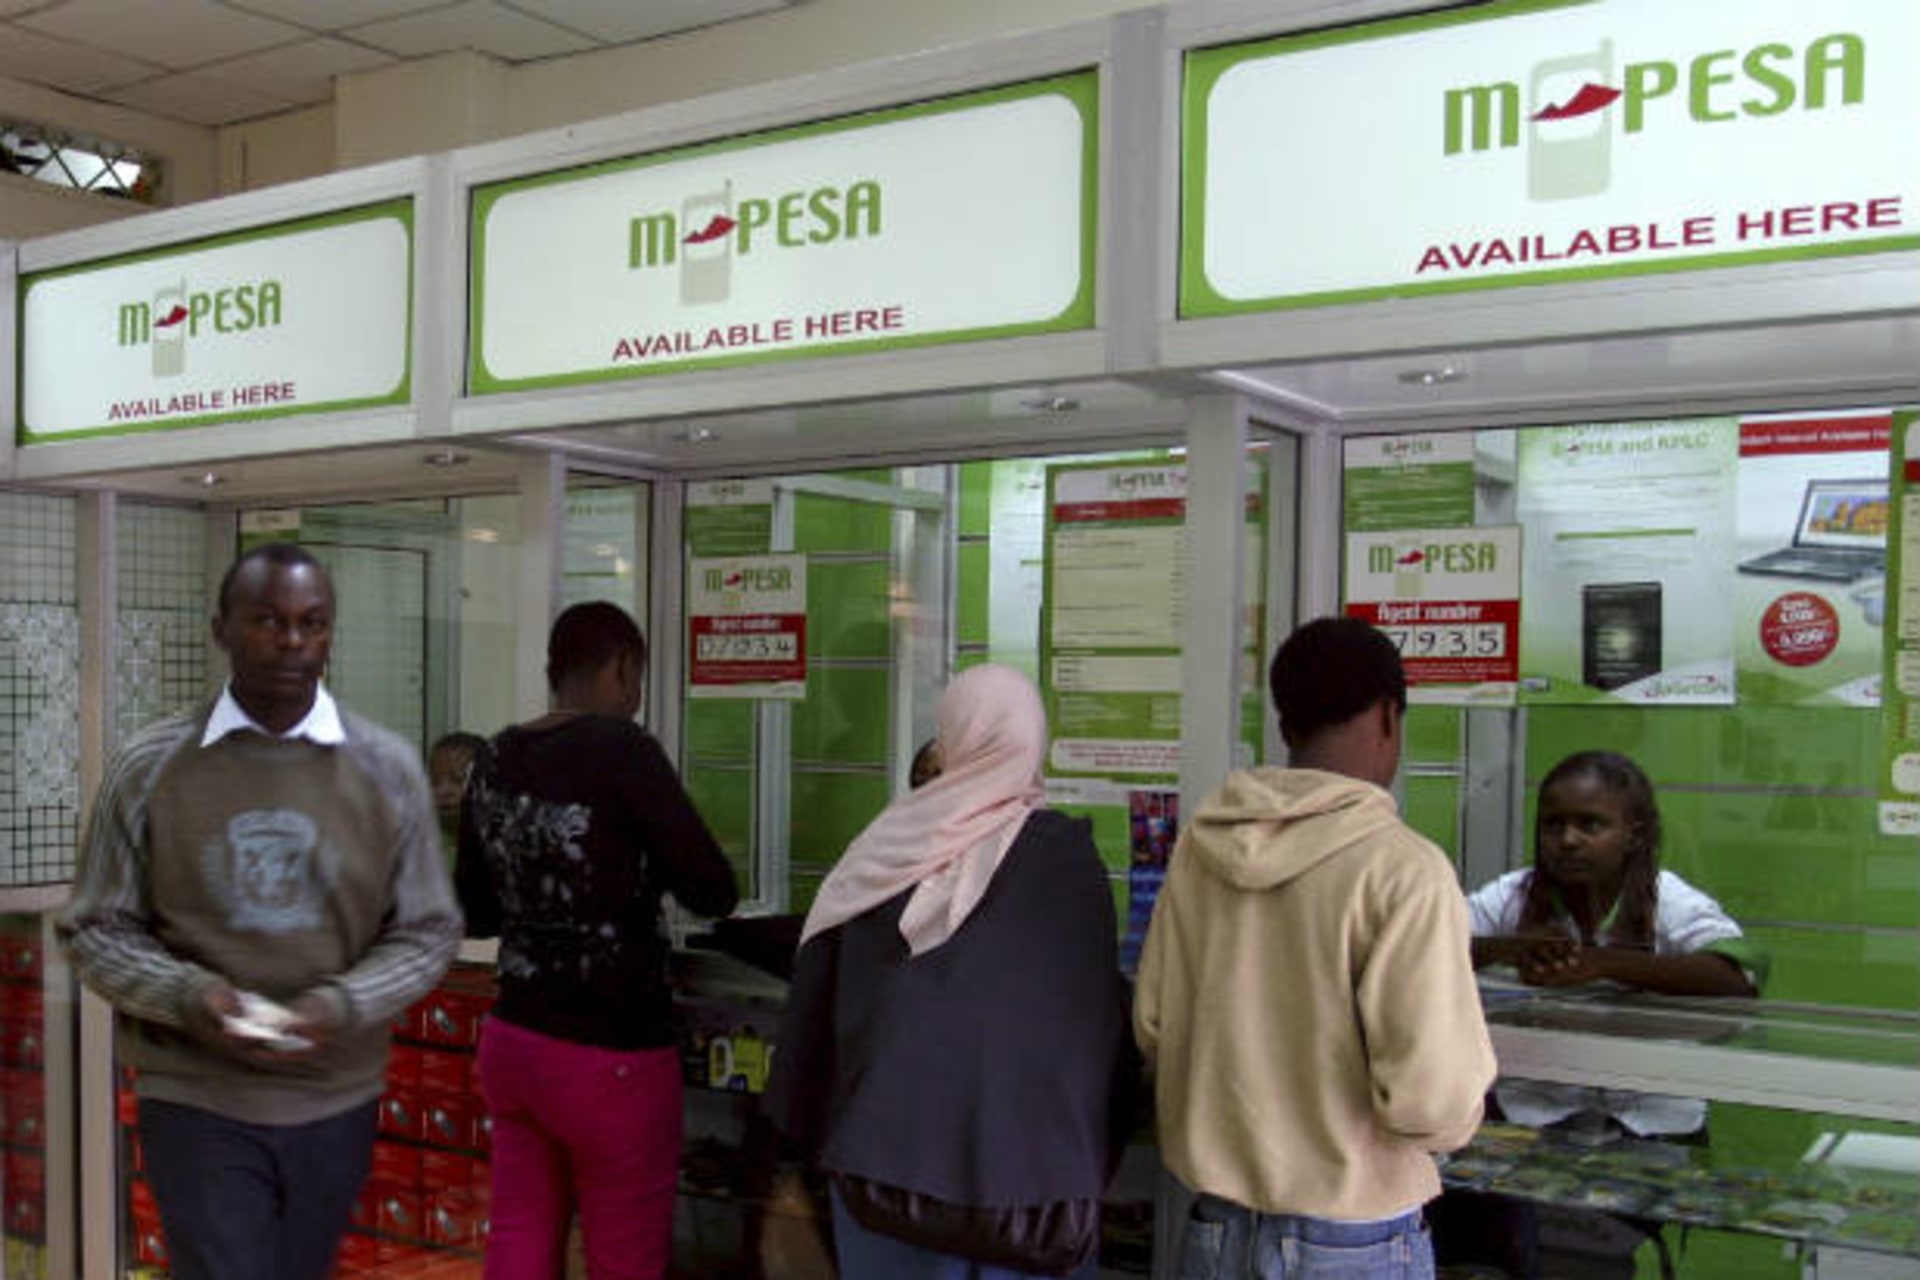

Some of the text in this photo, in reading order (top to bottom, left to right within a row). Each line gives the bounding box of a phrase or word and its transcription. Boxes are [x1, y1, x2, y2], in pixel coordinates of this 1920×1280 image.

[1416, 196, 1904, 274] AVAILABLE HERE
[612, 306, 905, 361] AVAILABLE HERE
[108, 382, 297, 421] AVAILABLE HERE
